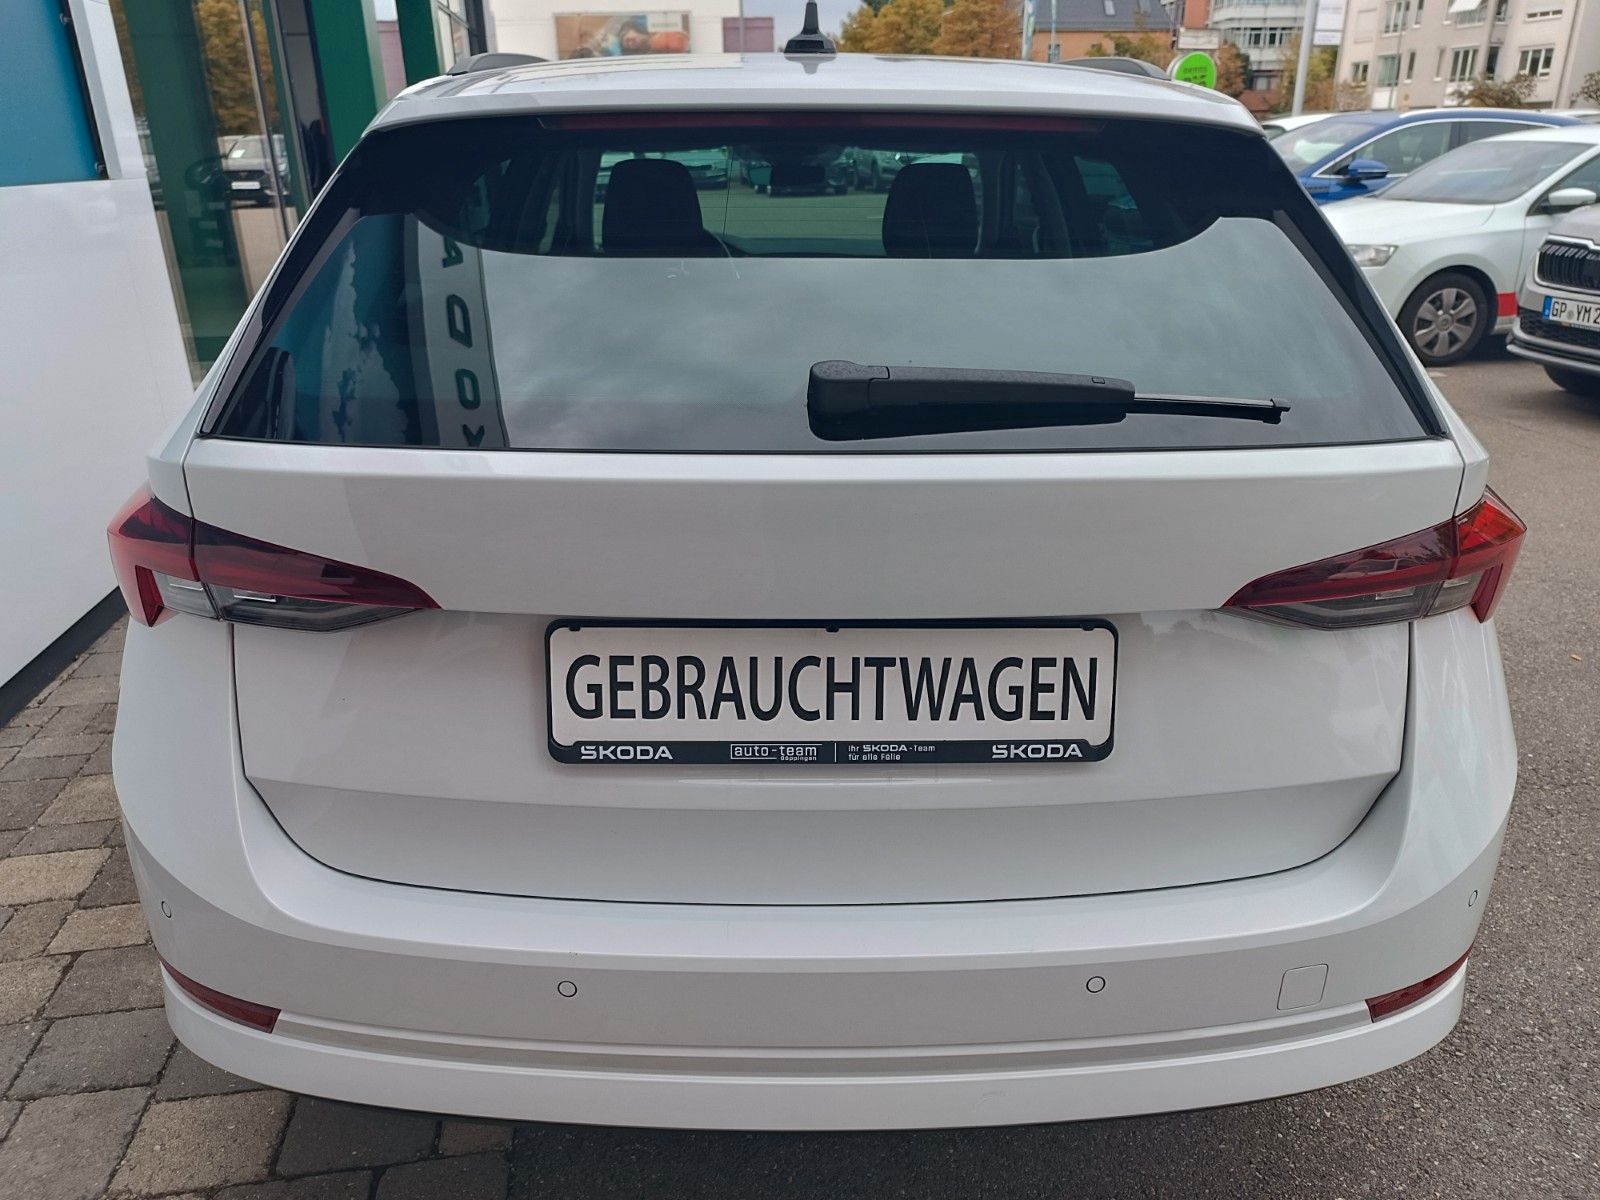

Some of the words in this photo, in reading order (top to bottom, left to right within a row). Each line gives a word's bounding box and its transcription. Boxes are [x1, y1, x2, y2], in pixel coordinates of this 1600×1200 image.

[1552, 301, 1567, 318] GP
[1577, 304, 1592, 323] YM
[565, 655, 1097, 722] GEBRAUCHTWAGEN
[734, 745, 817, 756] auto-team
[848, 753, 860, 761] für
[862, 753, 878, 761] alle
